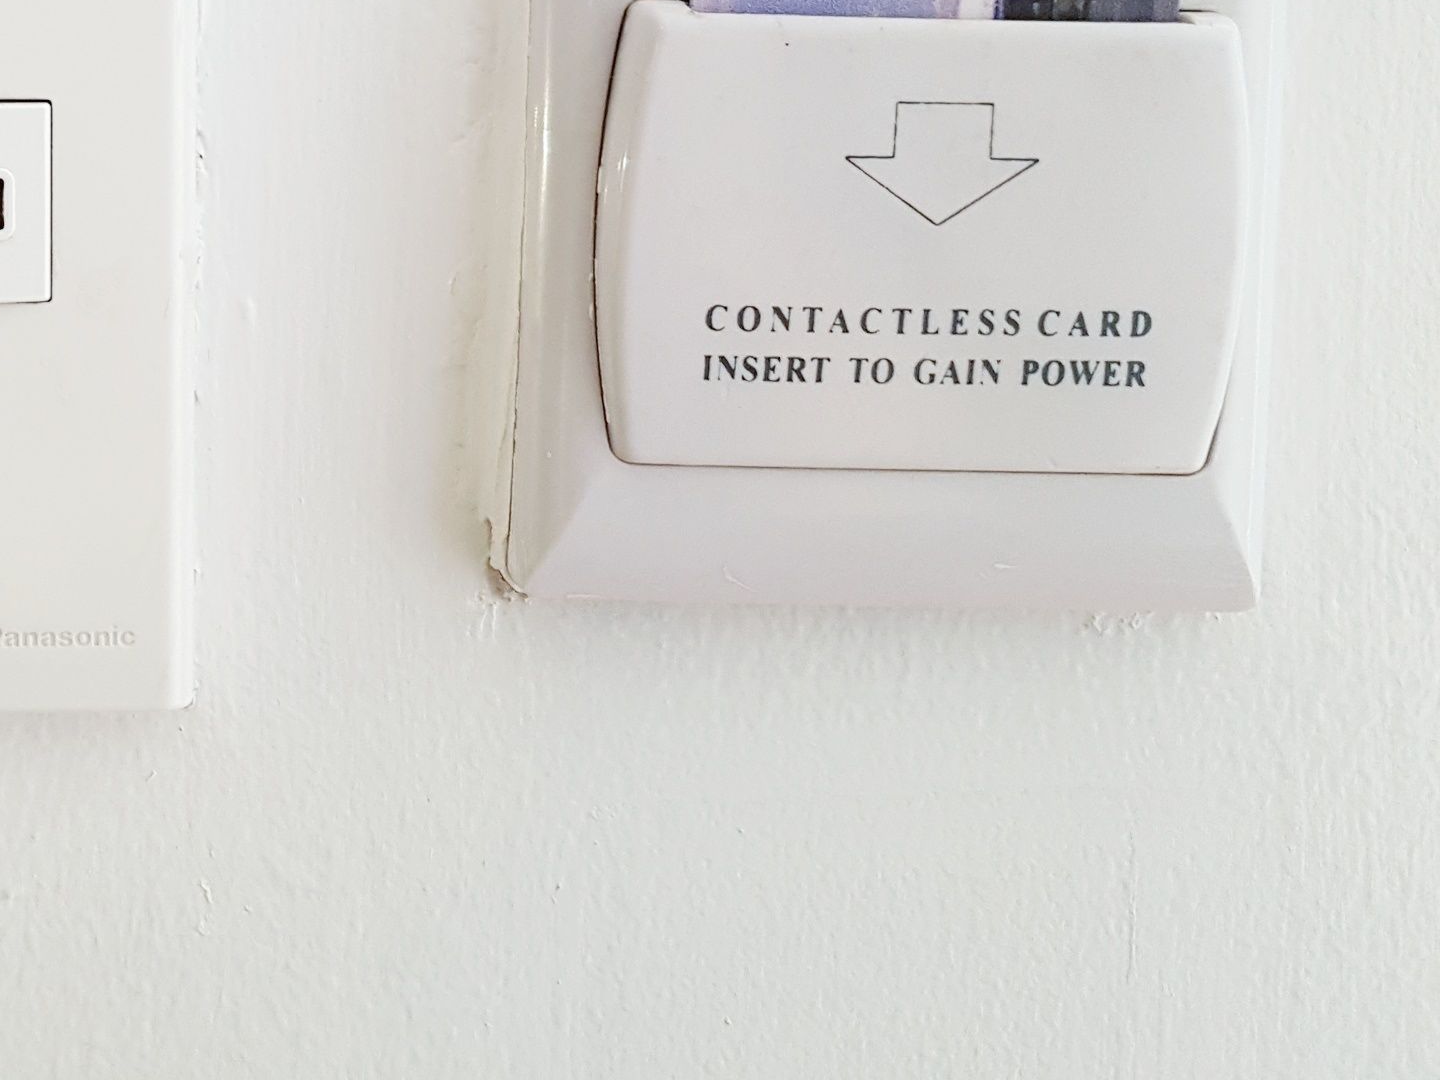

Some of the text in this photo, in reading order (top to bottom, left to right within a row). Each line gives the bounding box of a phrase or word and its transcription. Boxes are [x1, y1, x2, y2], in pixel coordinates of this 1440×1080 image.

[705, 304, 1153, 338] CONTACTLESS CARD
[703, 354, 1147, 388] INSERT TO GAIN POWER
